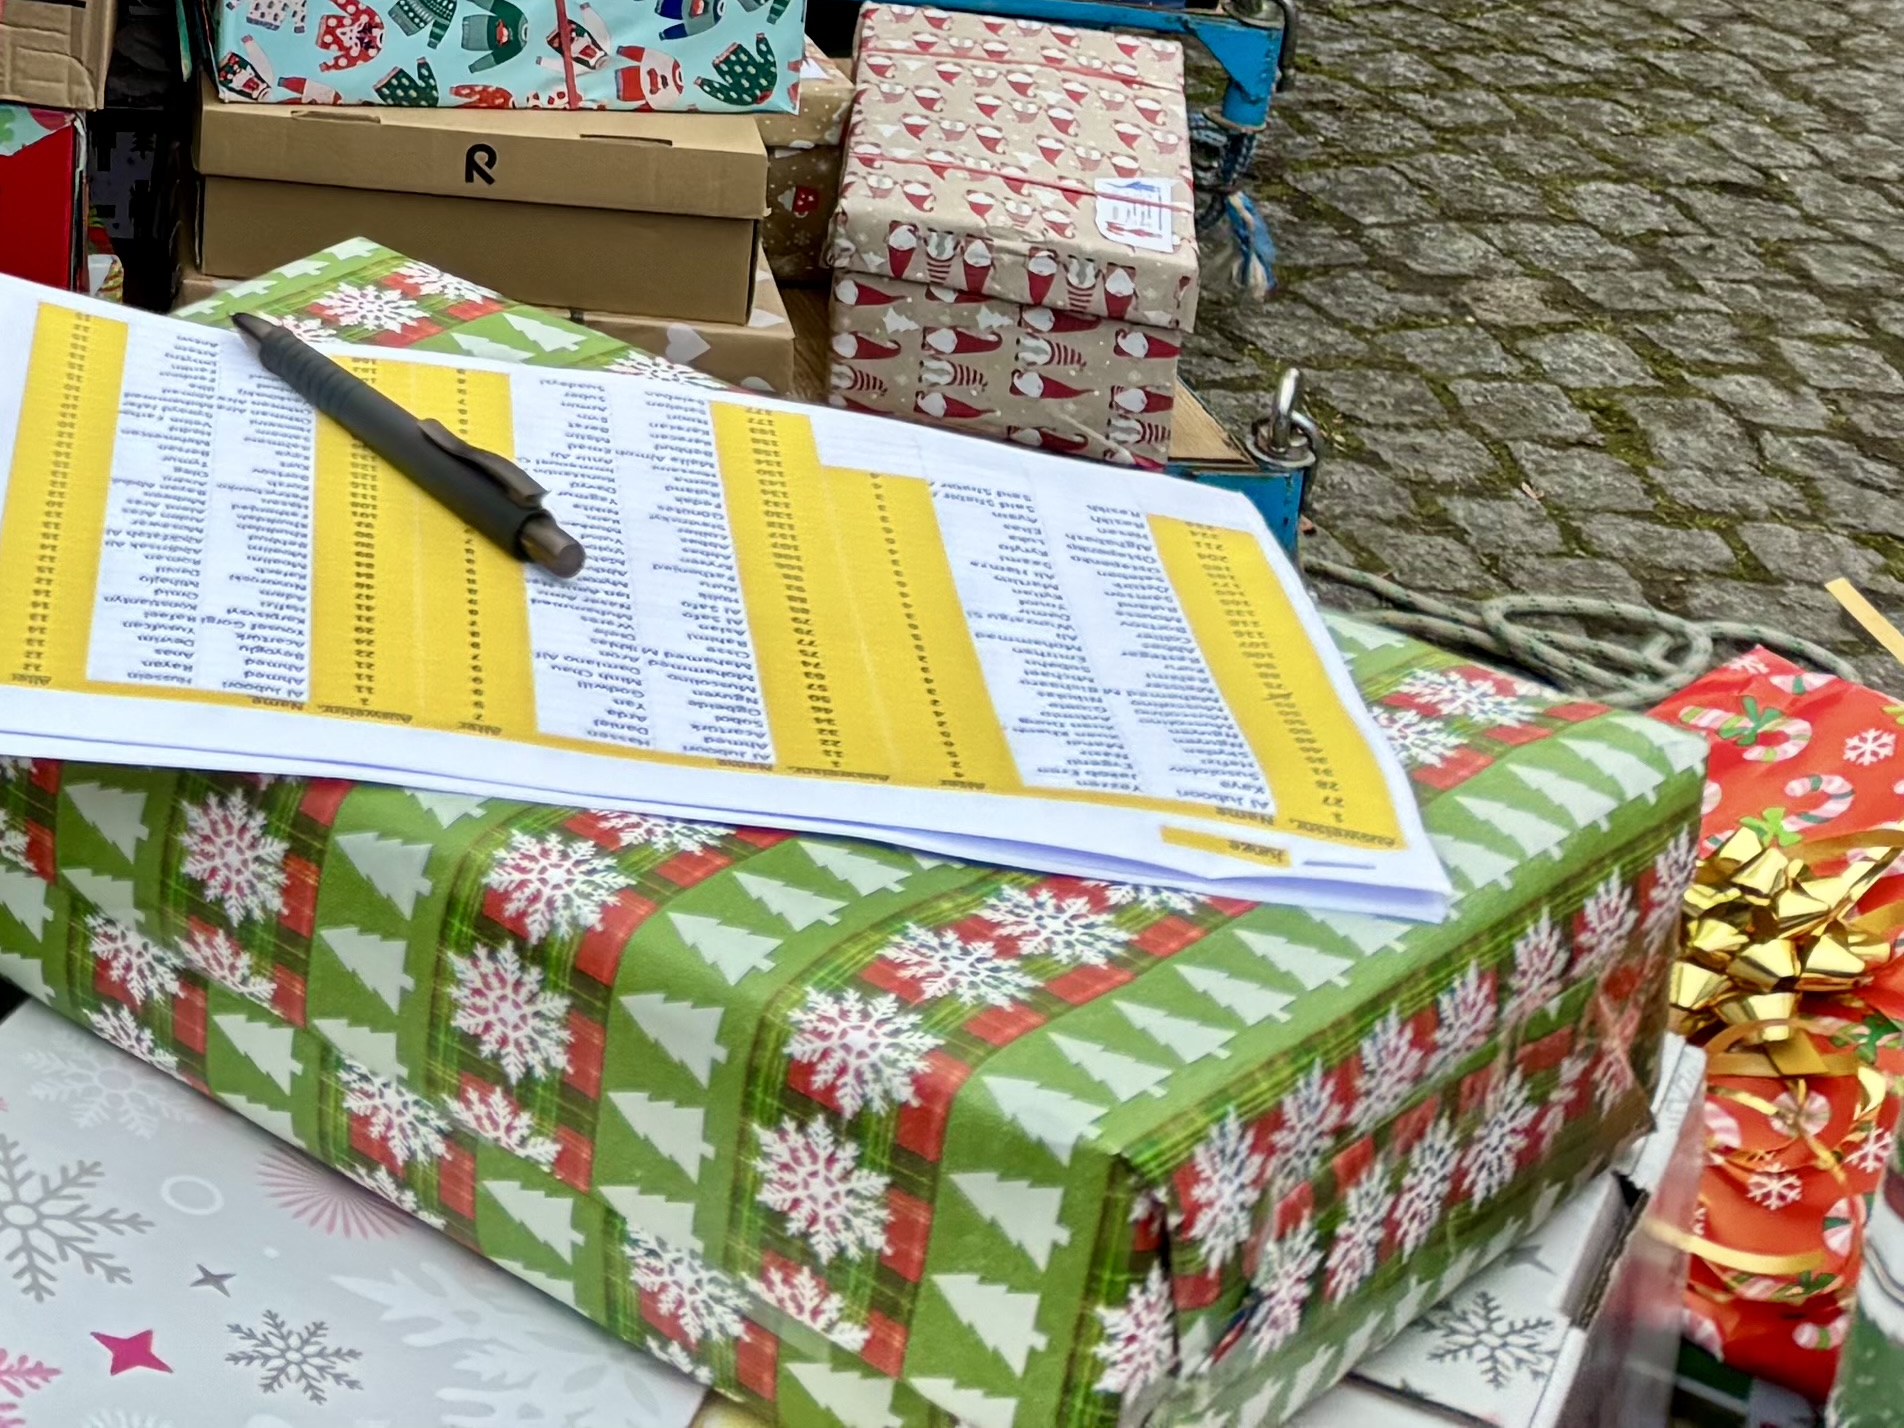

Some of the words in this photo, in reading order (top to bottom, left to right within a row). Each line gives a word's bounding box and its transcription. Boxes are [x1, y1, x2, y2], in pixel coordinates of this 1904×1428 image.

[244, 657, 305, 673] Ahmed
[243, 670, 305, 685] Ahmed
[250, 695, 304, 711] Name
